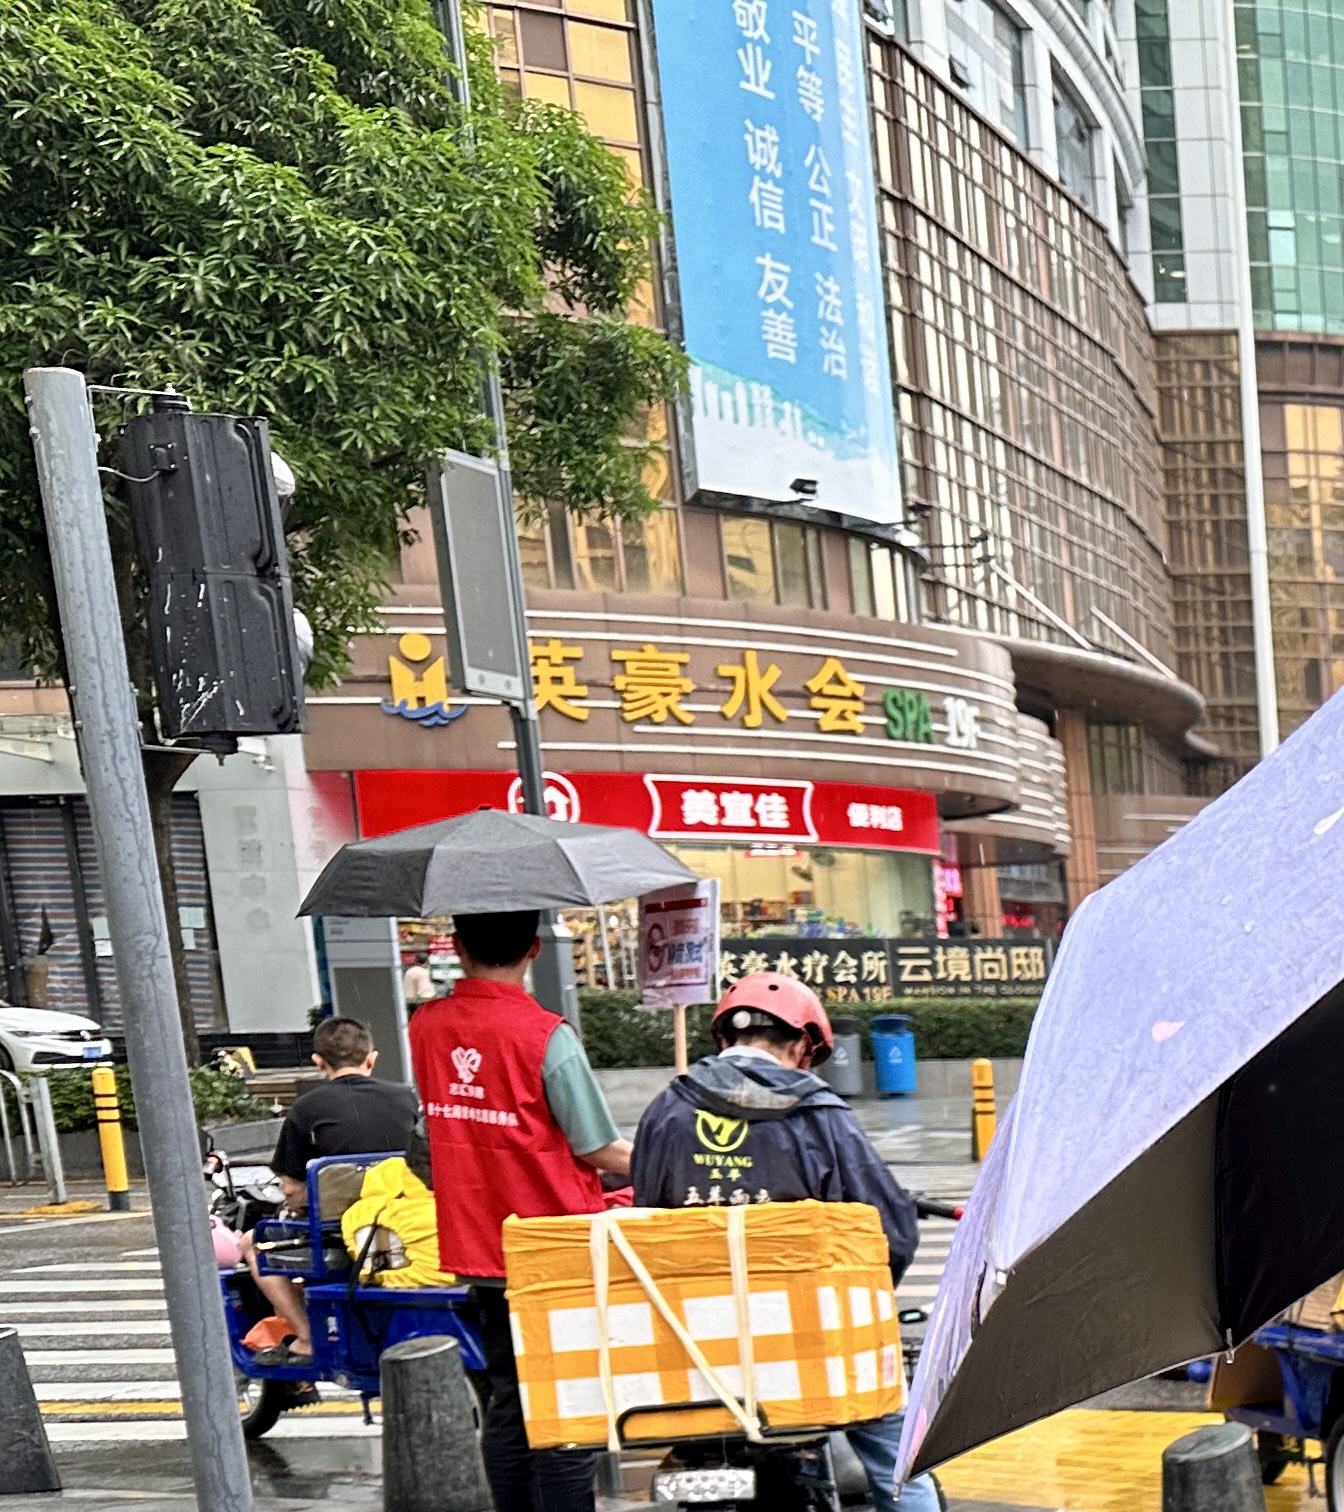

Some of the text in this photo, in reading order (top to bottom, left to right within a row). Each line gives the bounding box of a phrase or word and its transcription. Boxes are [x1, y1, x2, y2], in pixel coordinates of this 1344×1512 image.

[744, 118, 785, 235] 诚信
[792, 9, 848, 380] 平等 公正 法治
[755, 252, 798, 364] 友善
[528, 639, 865, 735] 英豪水会
[883, 688, 936, 744] SPA
[680, 788, 904, 832] 美宜佳 便利店
[897, 945, 1046, 983] 云境尚邸
[692, 1154, 753, 1168] WUYANG
